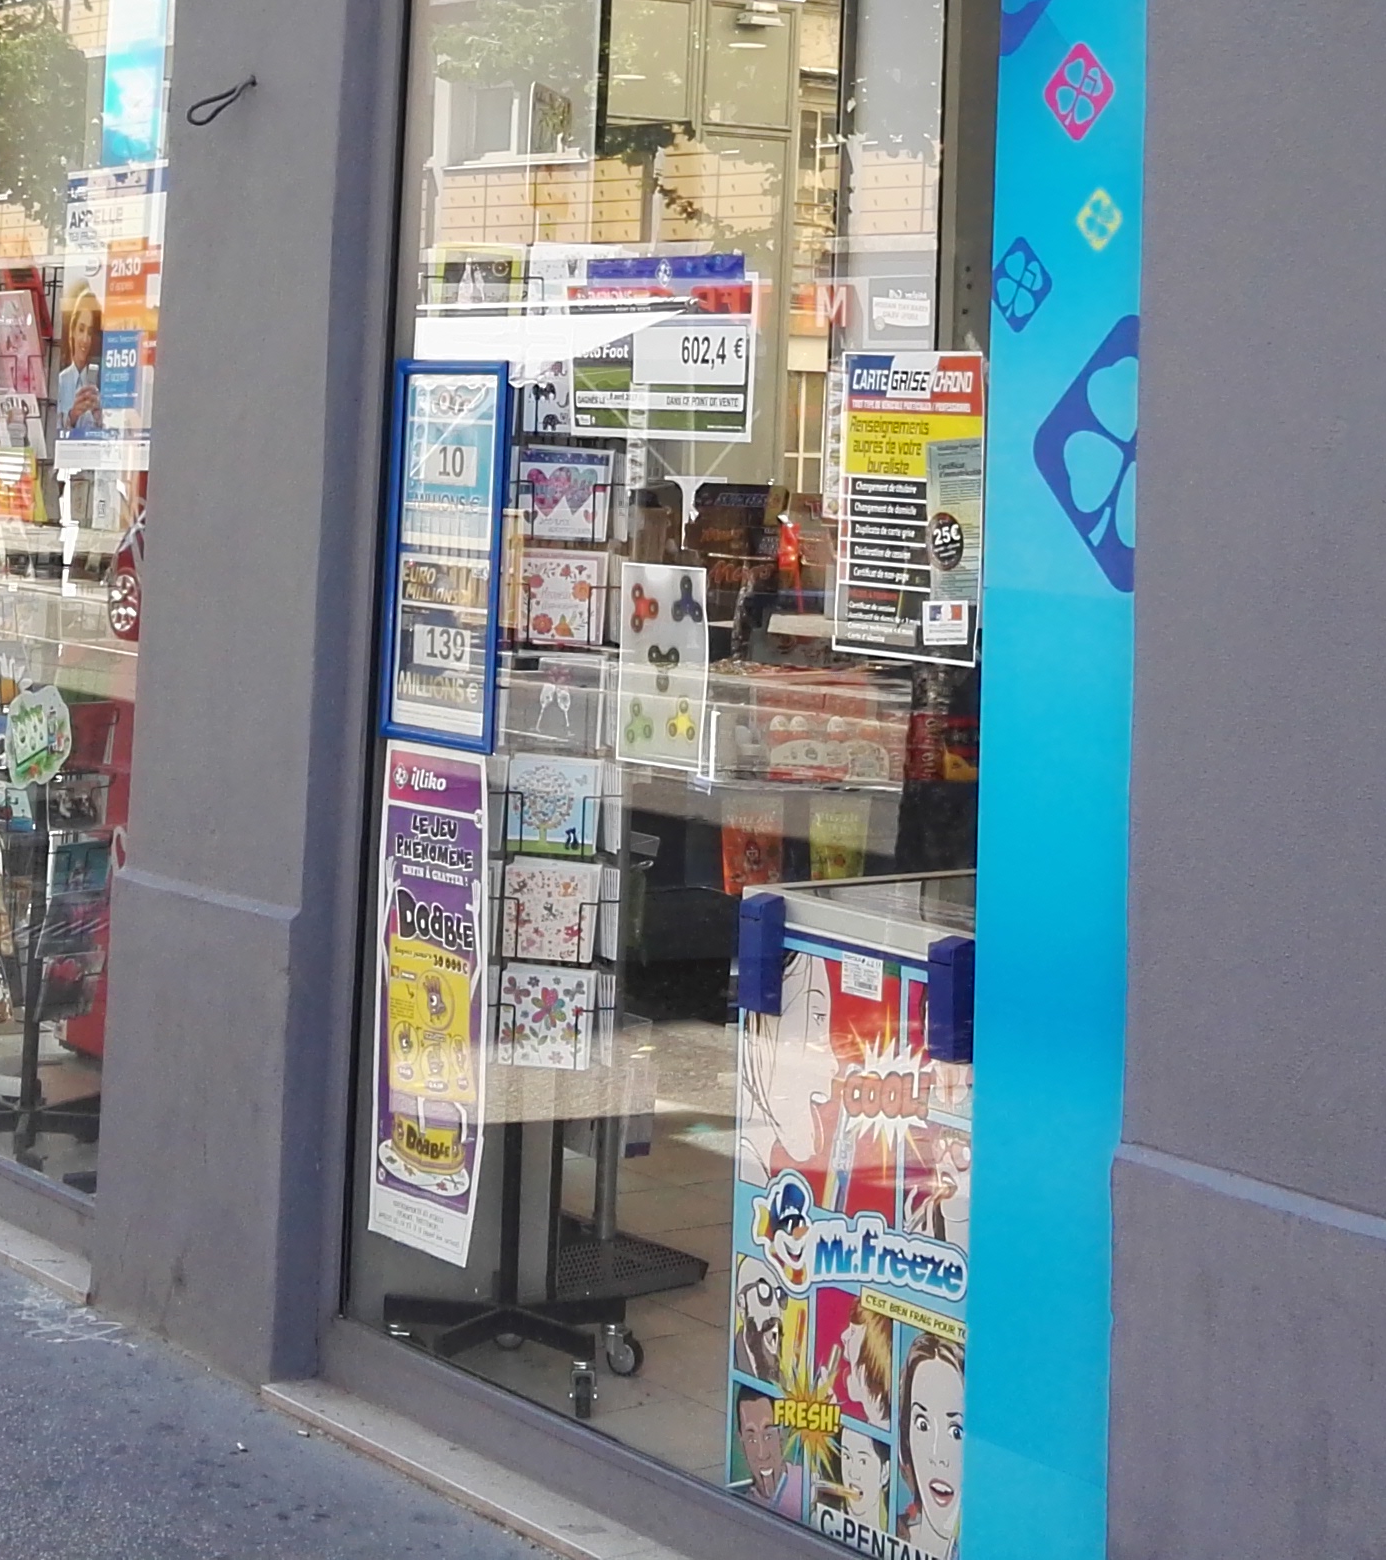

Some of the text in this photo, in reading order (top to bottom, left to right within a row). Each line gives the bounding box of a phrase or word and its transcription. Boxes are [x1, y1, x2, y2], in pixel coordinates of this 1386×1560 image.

[110, 257, 142, 278] 2h30
[105, 348, 137, 369] 5h50
[602, 343, 629, 359] Foot
[681, 336, 744, 371] 602,4 €
[852, 368, 974, 394] CARTE GRISE CHRONO
[850, 415, 930, 438] Renseignements
[853, 435, 922, 458] auprès de votre
[438, 446, 464, 477] 10
[866, 455, 910, 476] buraliste
[933, 523, 961, 546] 25€
[403, 564, 438, 585] EURO
[405, 583, 460, 605] MILLIONS
[425, 626, 465, 662] 139
[397, 670, 479, 704] MILLIONS €
[410, 767, 447, 792] illiko
[411, 815, 458, 840] LE JEU
[432, 868, 464, 886] GRATTER
[395, 886, 474, 950] DOBBLE
[843, 1070, 931, 1120] COOL!
[889, 1302, 908, 1318] BIEN
[909, 1310, 932, 1326] FRAIS
[933, 1318, 955, 1334] POUR
[774, 1398, 841, 1433] FRESH!
